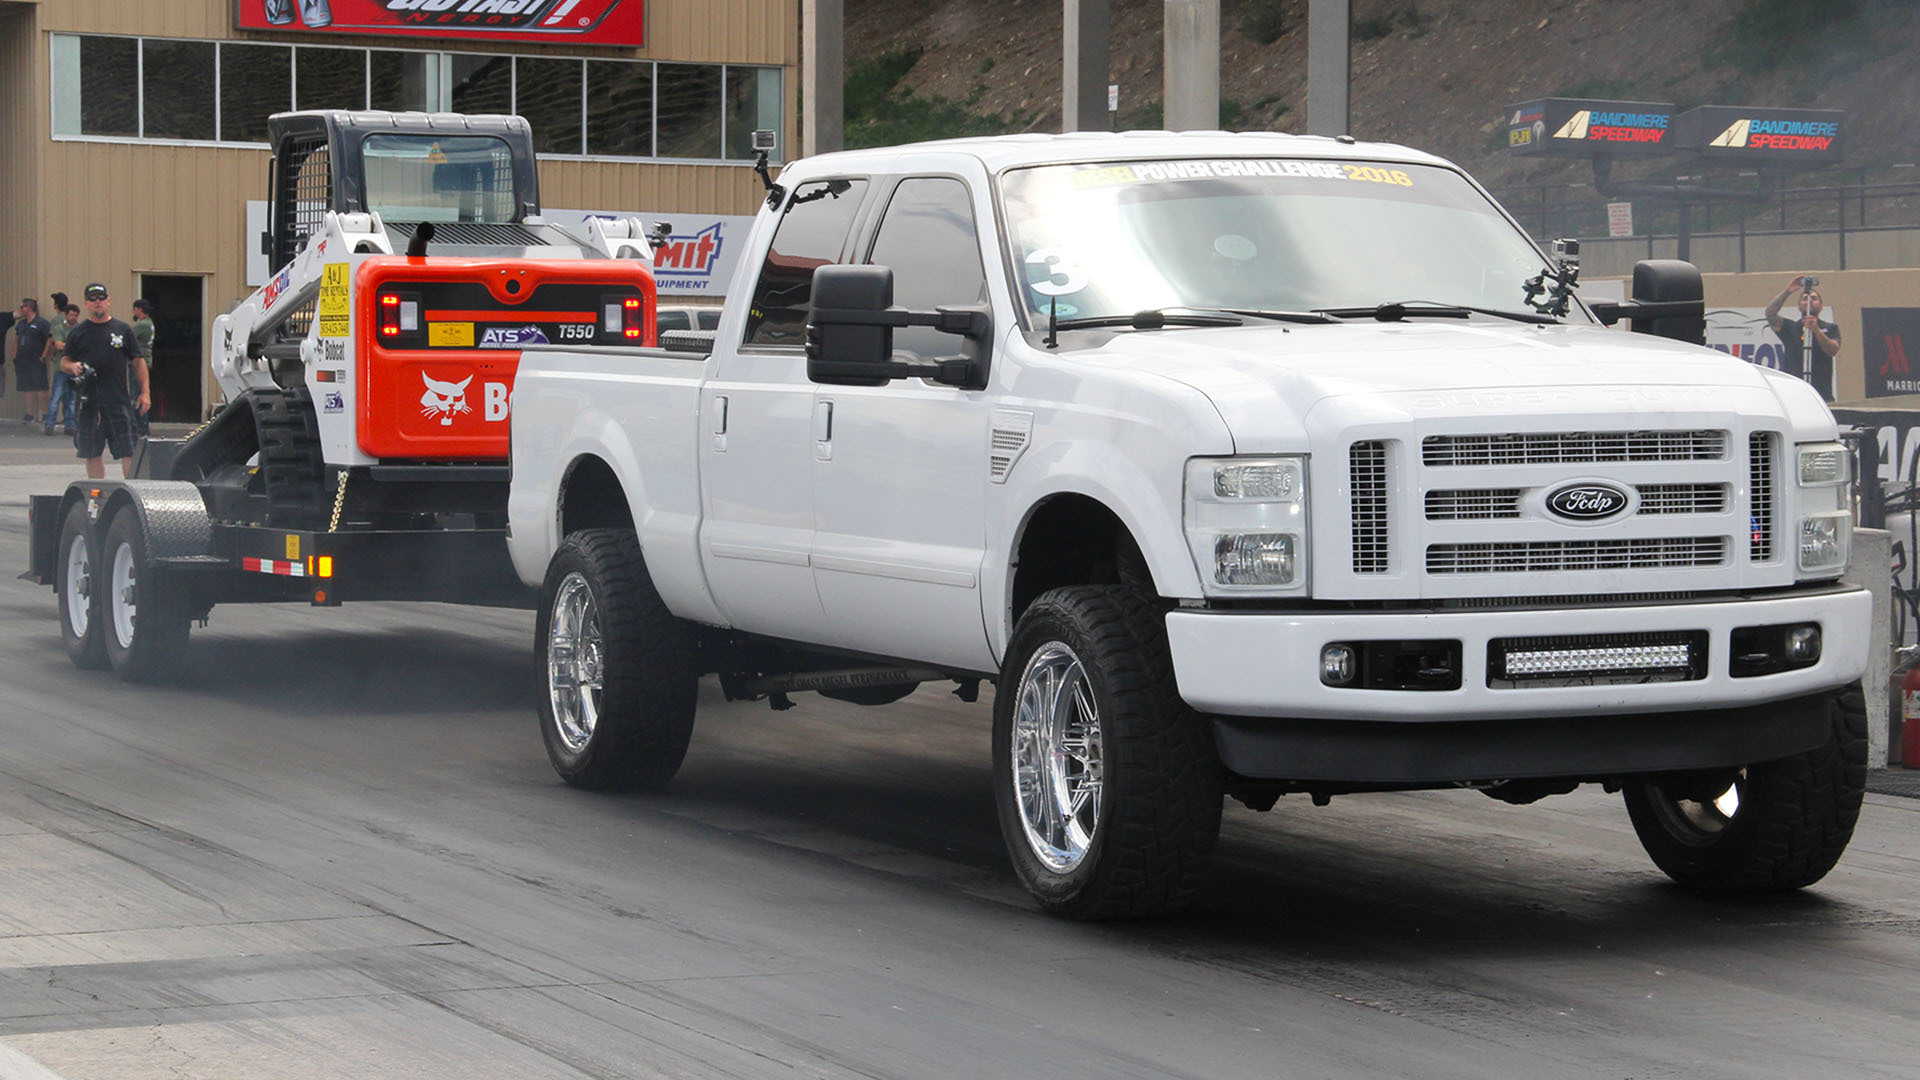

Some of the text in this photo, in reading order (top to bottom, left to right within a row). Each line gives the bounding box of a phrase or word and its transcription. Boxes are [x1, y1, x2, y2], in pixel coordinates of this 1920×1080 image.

[1589, 111, 1669, 128] BANDIMERE
[1749, 119, 1839, 136] BANDIMERE
[1588, 126, 1665, 143] SPEEDWAY
[1749, 133, 1833, 150] SPEEDWAY
[1132, 162, 1215, 181] POWER
[1211, 160, 1348, 179] CHALLENGE
[1343, 165, 1414, 187] 2016
[1025, 248, 1089, 296] 3
[654, 279, 709, 289] UIPMENT
[483, 329, 520, 343] ATS
[558, 325, 595, 339] T550
